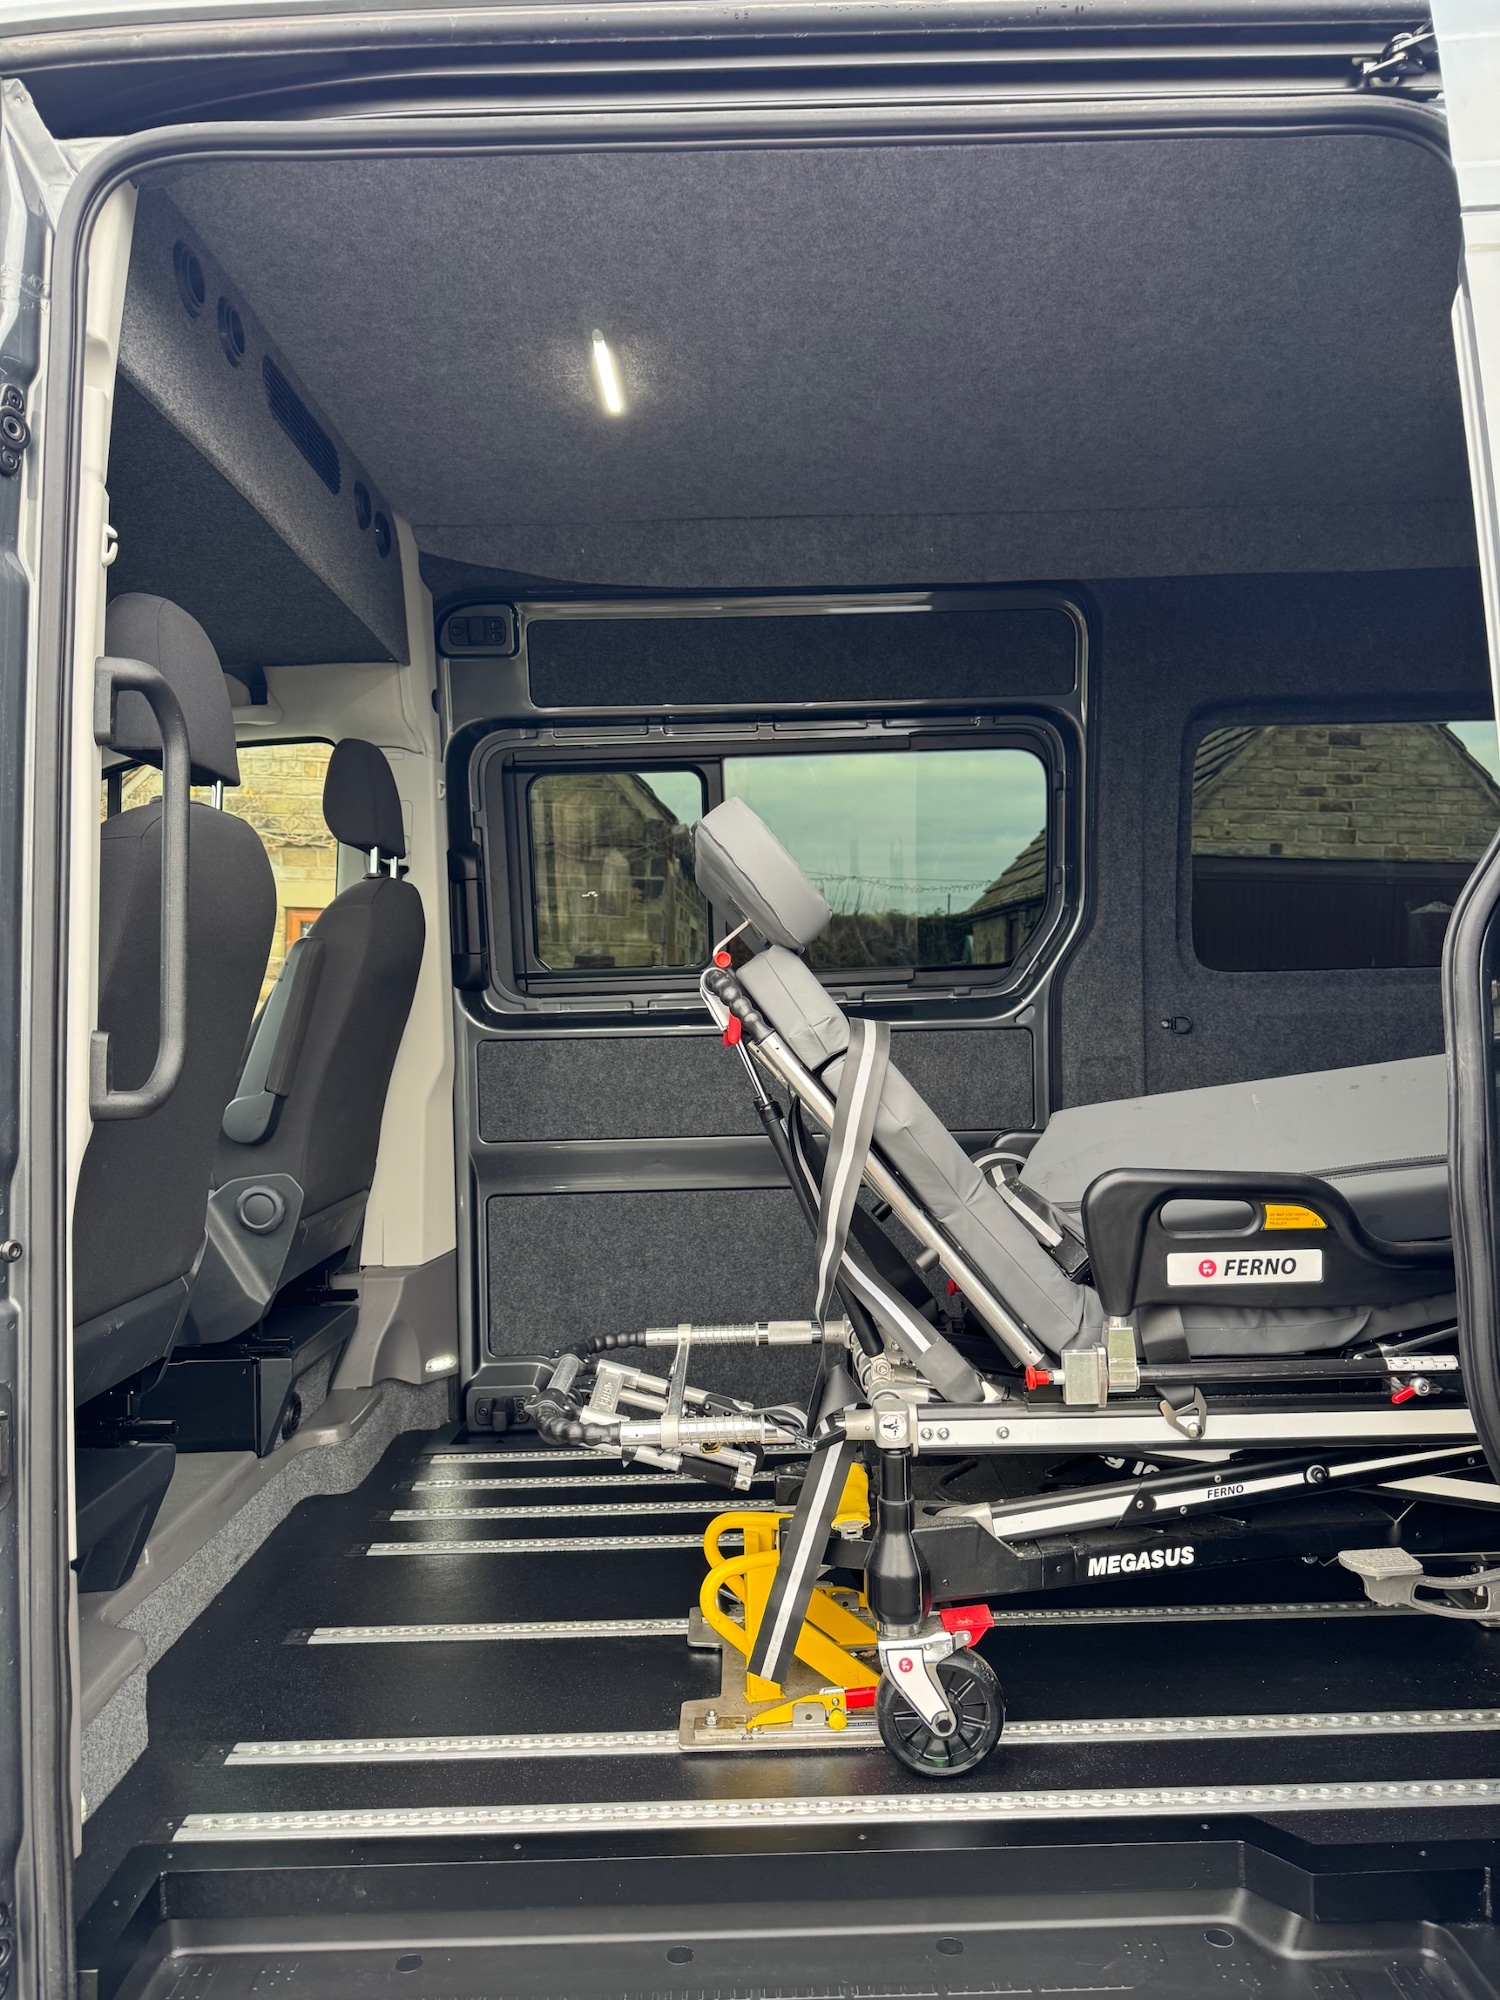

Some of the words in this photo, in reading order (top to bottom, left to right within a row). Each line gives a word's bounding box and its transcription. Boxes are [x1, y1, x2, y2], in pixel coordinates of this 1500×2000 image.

[1224, 1258, 1297, 1276] FERNO
[1207, 1485, 1244, 1499] FERNO
[1088, 1546, 1195, 1577] MEGASUS
